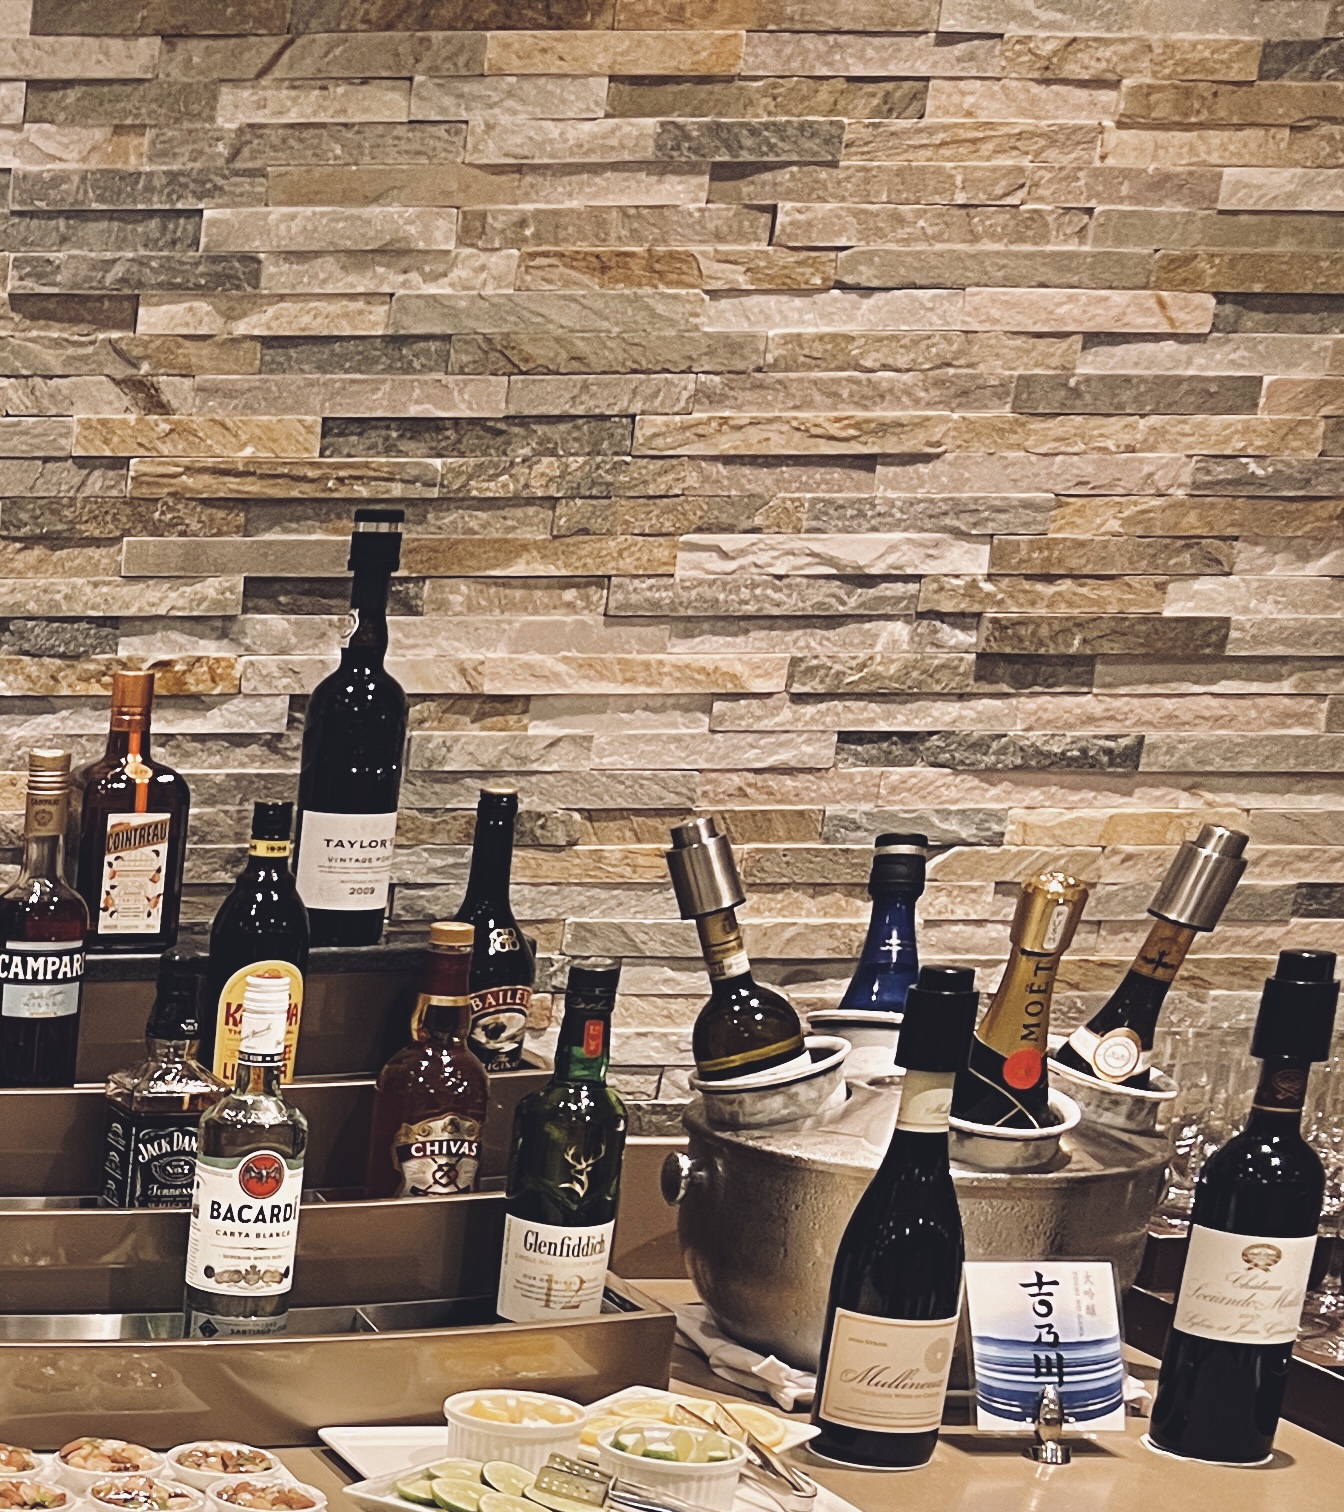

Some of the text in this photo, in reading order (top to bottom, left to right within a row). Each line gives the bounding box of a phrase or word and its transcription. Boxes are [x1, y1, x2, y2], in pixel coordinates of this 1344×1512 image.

[107, 821, 168, 852] COINTREAU
[328, 855, 373, 864] VINTAGE
[1020, 961, 1055, 1042] MOËT
[138, 1138, 171, 1163] JACK
[410, 1140, 478, 1157] CHIVAS
[215, 1229, 250, 1239] CARTA
